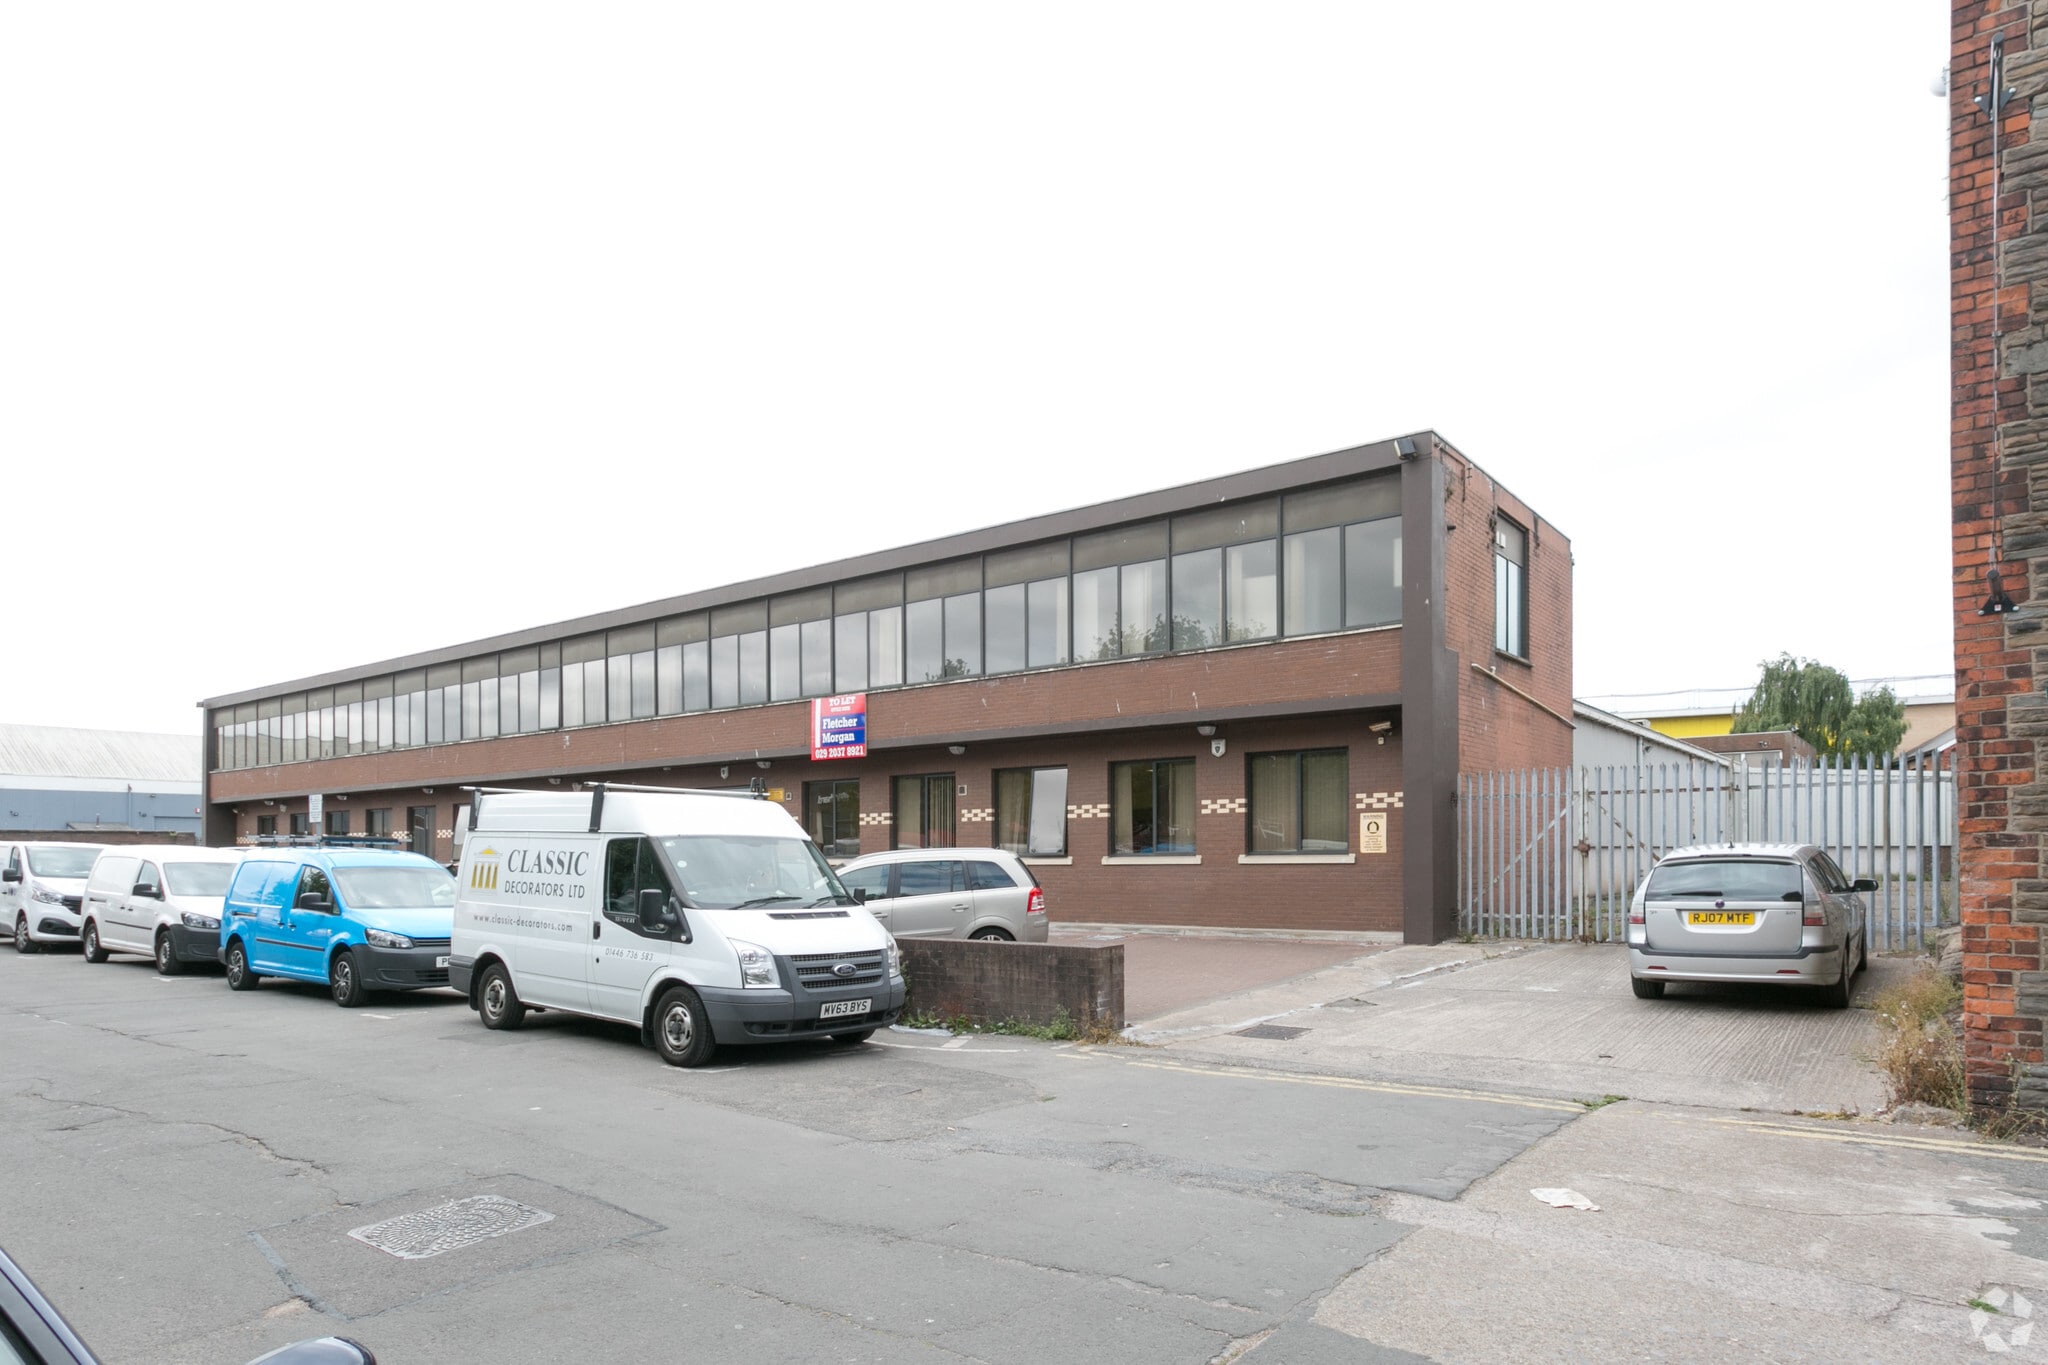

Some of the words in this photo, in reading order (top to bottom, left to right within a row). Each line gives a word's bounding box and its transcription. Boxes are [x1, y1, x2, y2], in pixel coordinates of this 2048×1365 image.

[841, 696, 856, 704] LET
[822, 717, 858, 729] Fletcher
[822, 732, 855, 744] Morgan
[816, 748, 828, 758] 029
[828, 748, 846, 758] 2037
[508, 849, 589, 876] CLASSIC
[504, 880, 564, 898] DECORATORS
[568, 884, 586, 899] LTD
[473, 913, 573, 932] www.classic-decorators.com
[1693, 913, 1723, 923] RJ07
[1726, 913, 1750, 923] MTF
[605, 947, 624, 958] 01446
[626, 950, 639, 960] 736
[640, 951, 654, 961] 583
[824, 1003, 848, 1016] MV63
[850, 1000, 867, 1012] BYS
